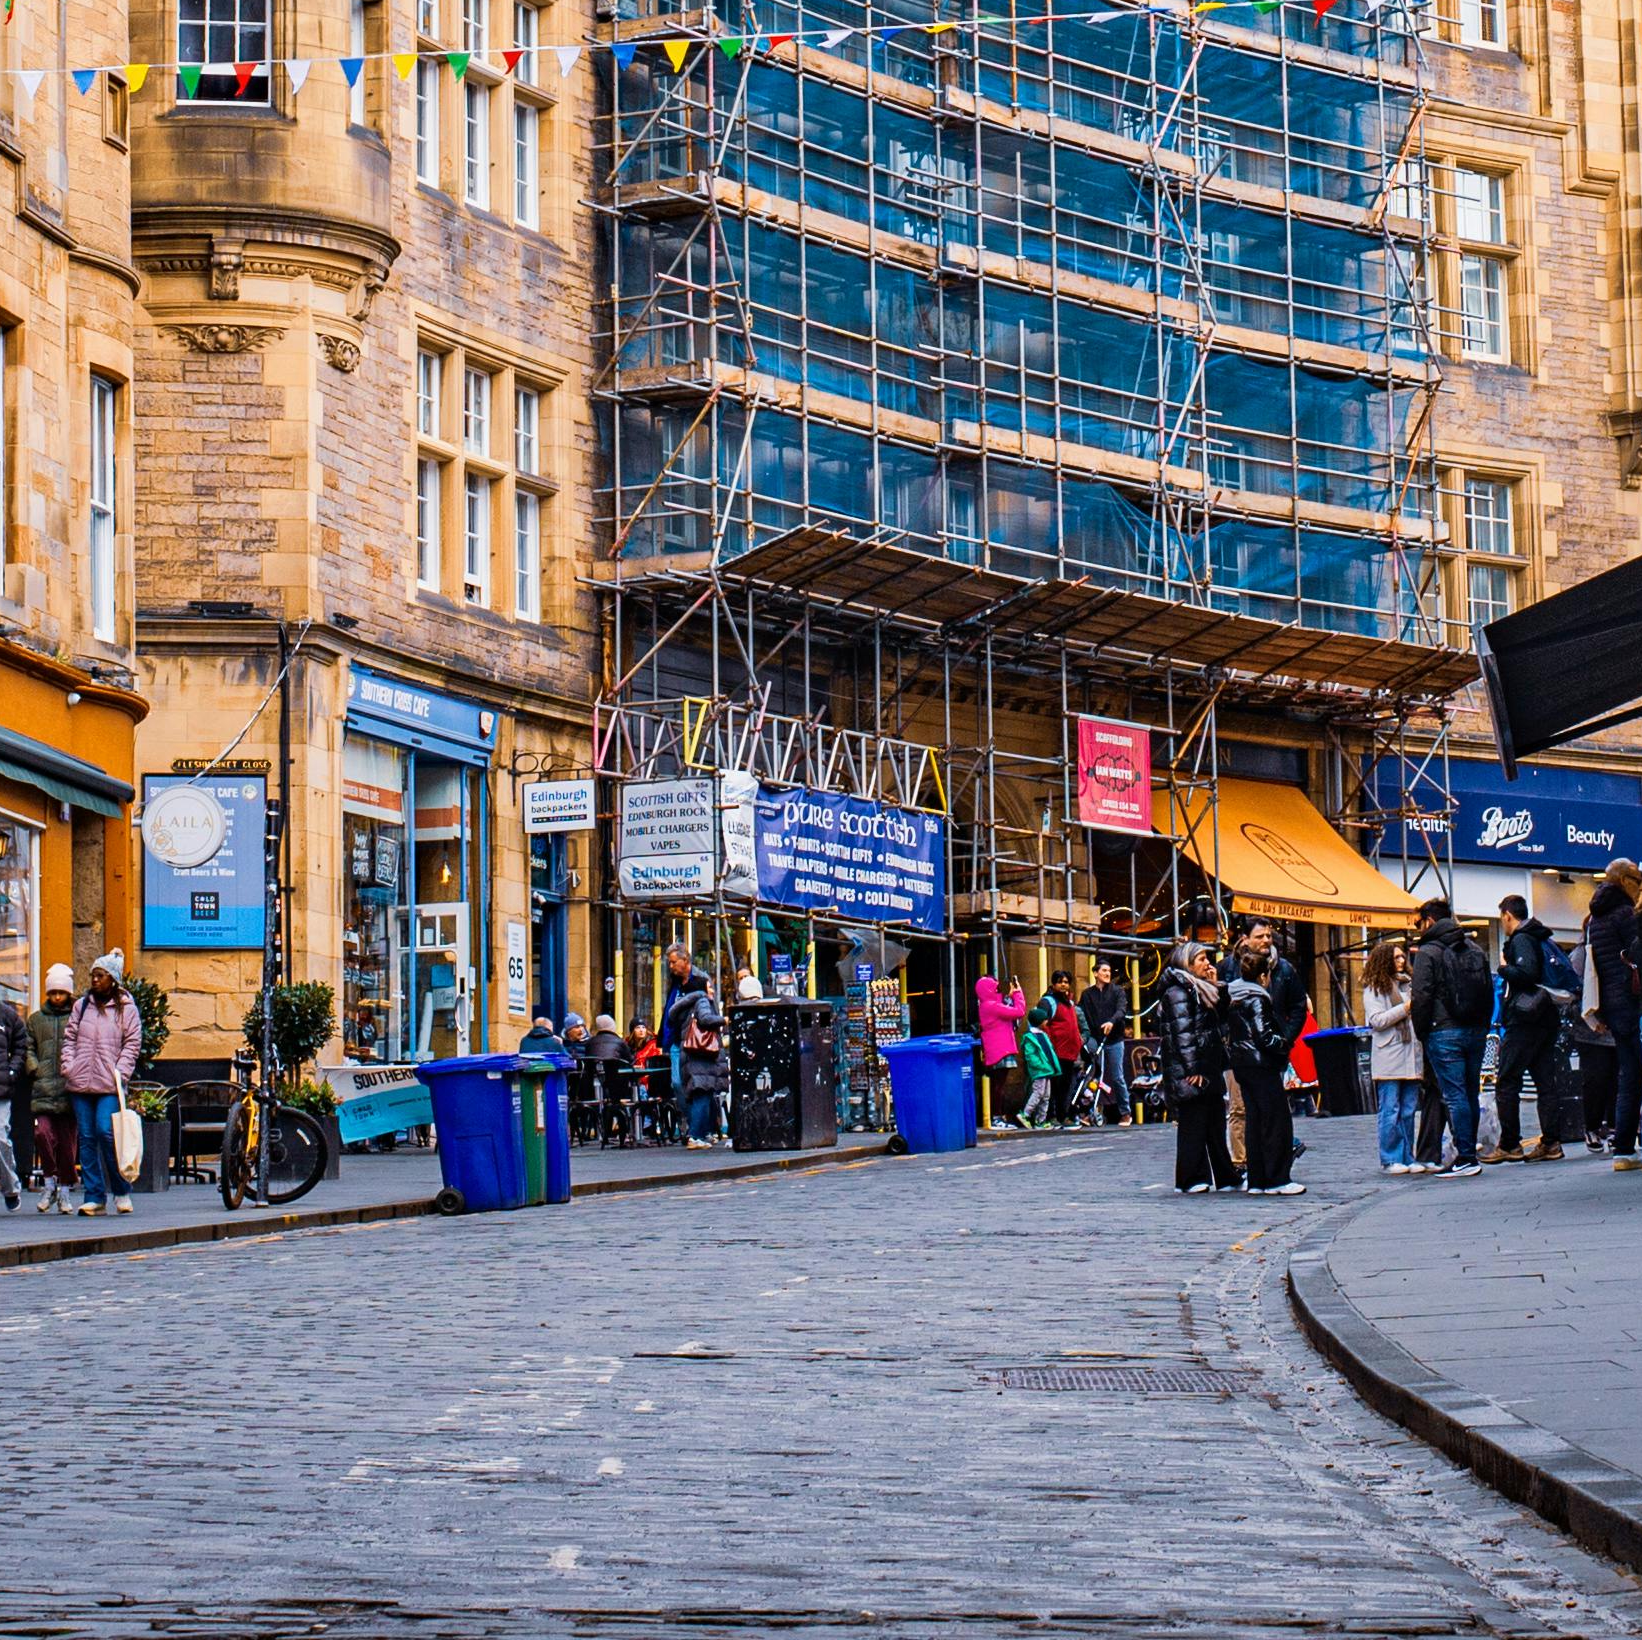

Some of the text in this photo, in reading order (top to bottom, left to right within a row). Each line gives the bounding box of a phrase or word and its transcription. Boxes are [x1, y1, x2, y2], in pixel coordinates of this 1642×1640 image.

[361, 680, 431, 718] SOUTHERN CROSS CAFE
[531, 789, 587, 802] Edinburgh
[628, 792, 674, 808] SCOTTISH
[677, 791, 707, 804] GIFTS
[531, 802, 587, 814] backpackers
[628, 808, 707, 822] EDINBURGH ROCK
[158, 816, 212, 829] LAILA
[1477, 806, 1534, 850] Boots
[625, 823, 710, 838] MOBILE CHARGERS
[1567, 824, 1615, 851] Beauty
[650, 840, 681, 851] VAPES
[763, 832, 783, 848] HATS
[852, 848, 873, 864] GIFTS
[1517, 842, 1532, 852] Since
[632, 865, 701, 879] Edinburgh
[856, 869, 897, 888] CHARGERS
[633, 879, 701, 891] Backpackers
[865, 890, 889, 906] COLD
[1249, 901, 1314, 919] ALL DAY BREAKFAST
[508, 956, 524, 980] 65
